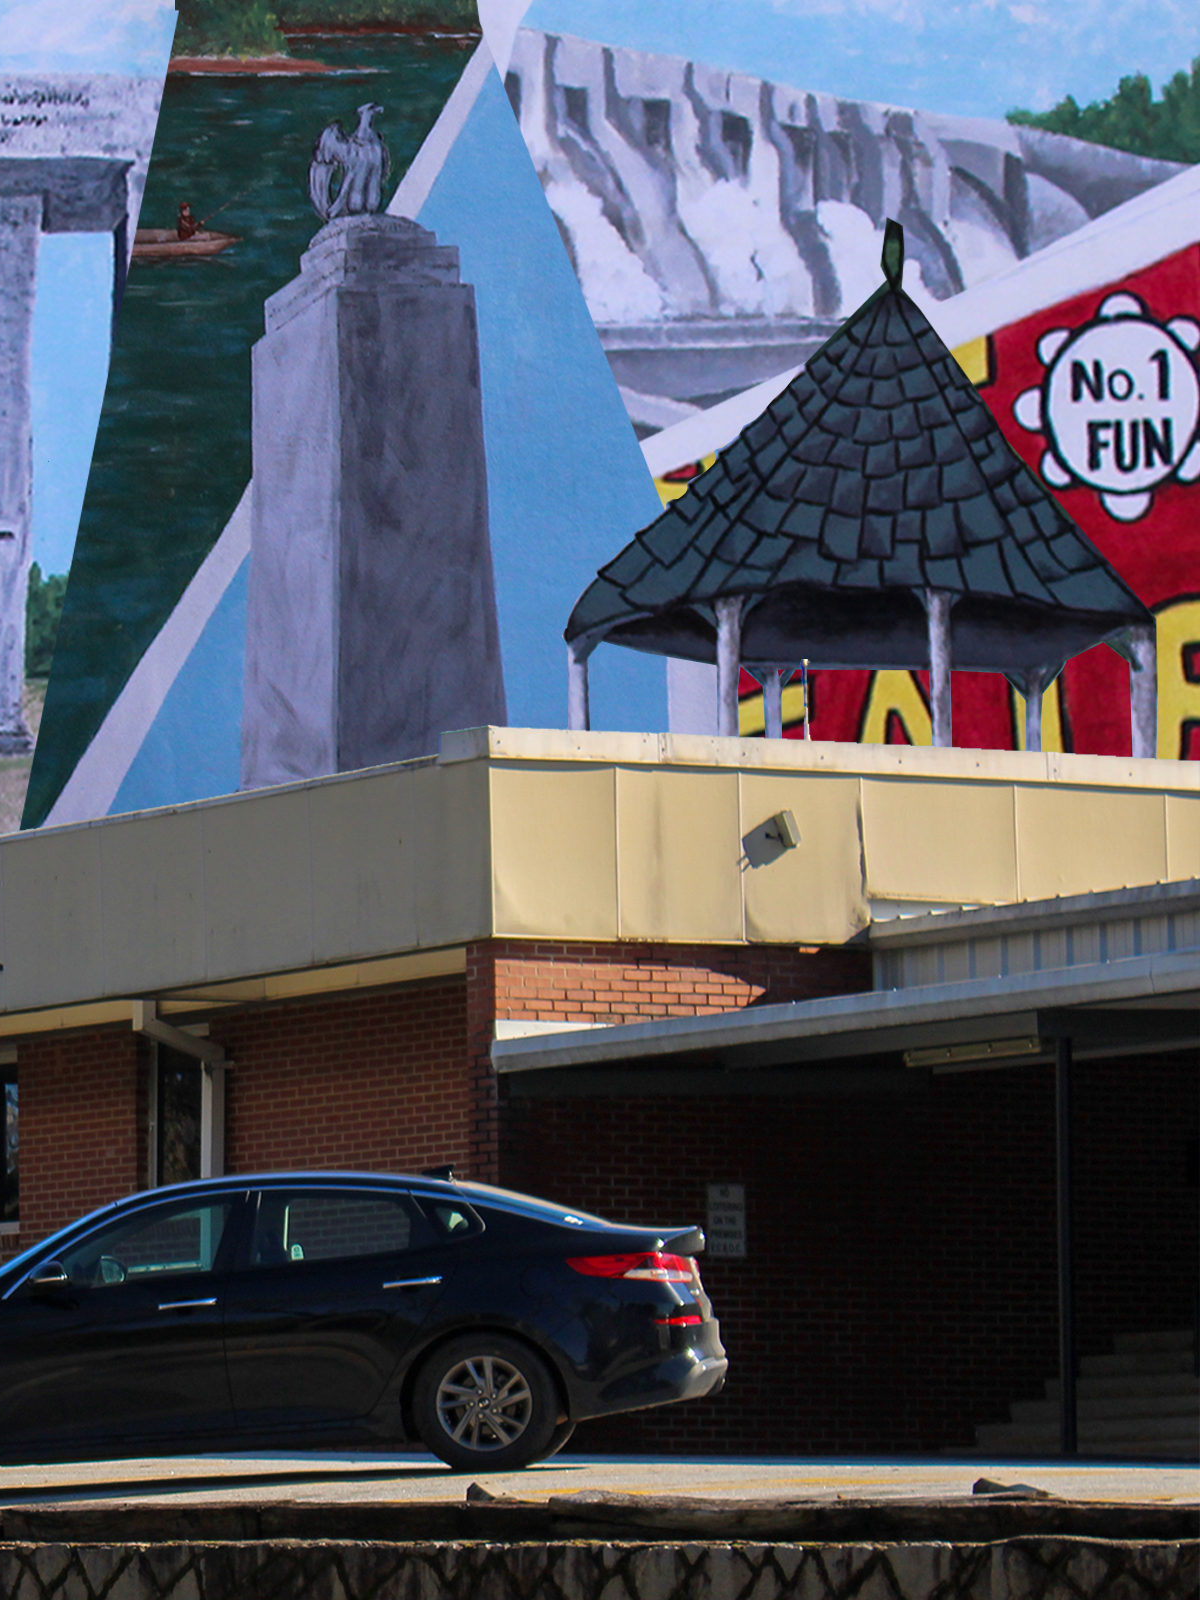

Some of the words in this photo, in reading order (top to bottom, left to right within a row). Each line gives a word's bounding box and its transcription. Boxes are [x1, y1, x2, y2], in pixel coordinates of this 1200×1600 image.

[1071, 359, 1144, 403] No.
[1149, 348, 1170, 401] 1
[1087, 417, 1174, 474] FUN
